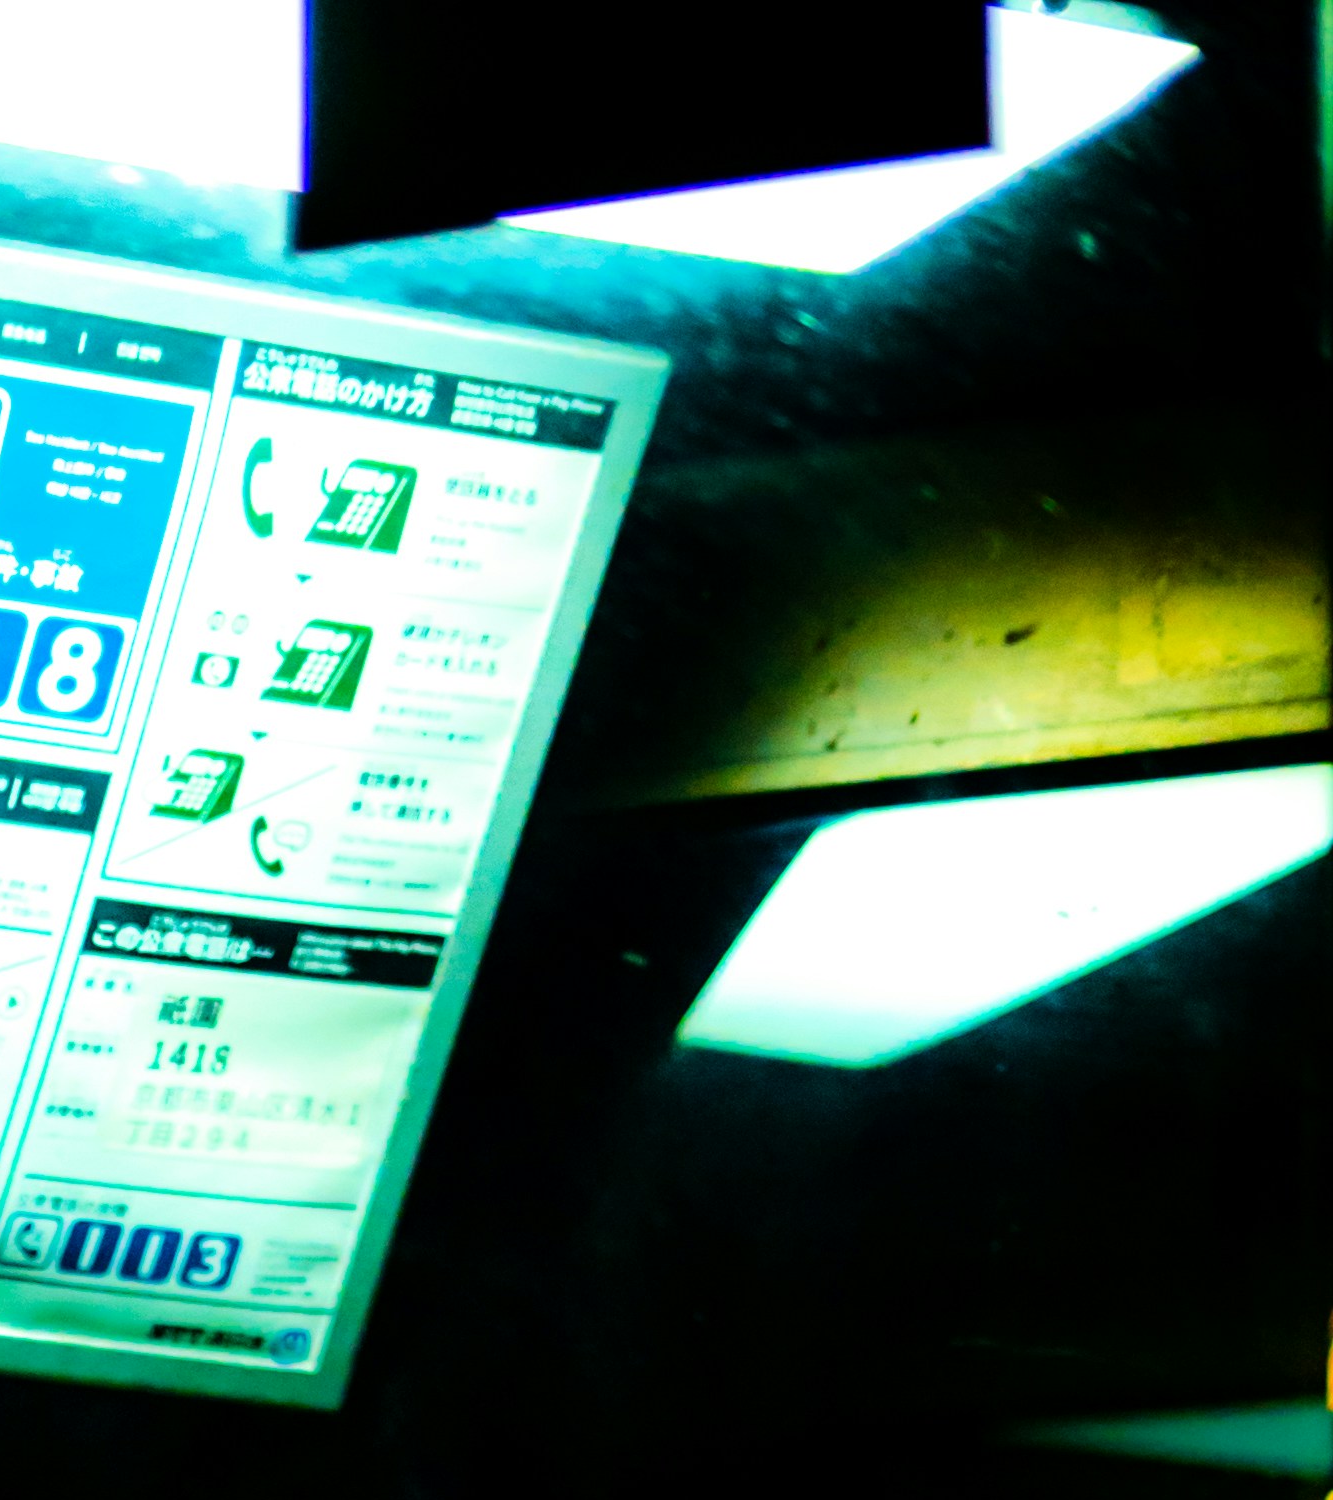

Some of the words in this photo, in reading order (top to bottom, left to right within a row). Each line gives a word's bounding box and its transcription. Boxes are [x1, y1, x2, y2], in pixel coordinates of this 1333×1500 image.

[240, 360, 435, 418] 公衆電話のかけ方
[77, 1227, 225, 1285] 113
